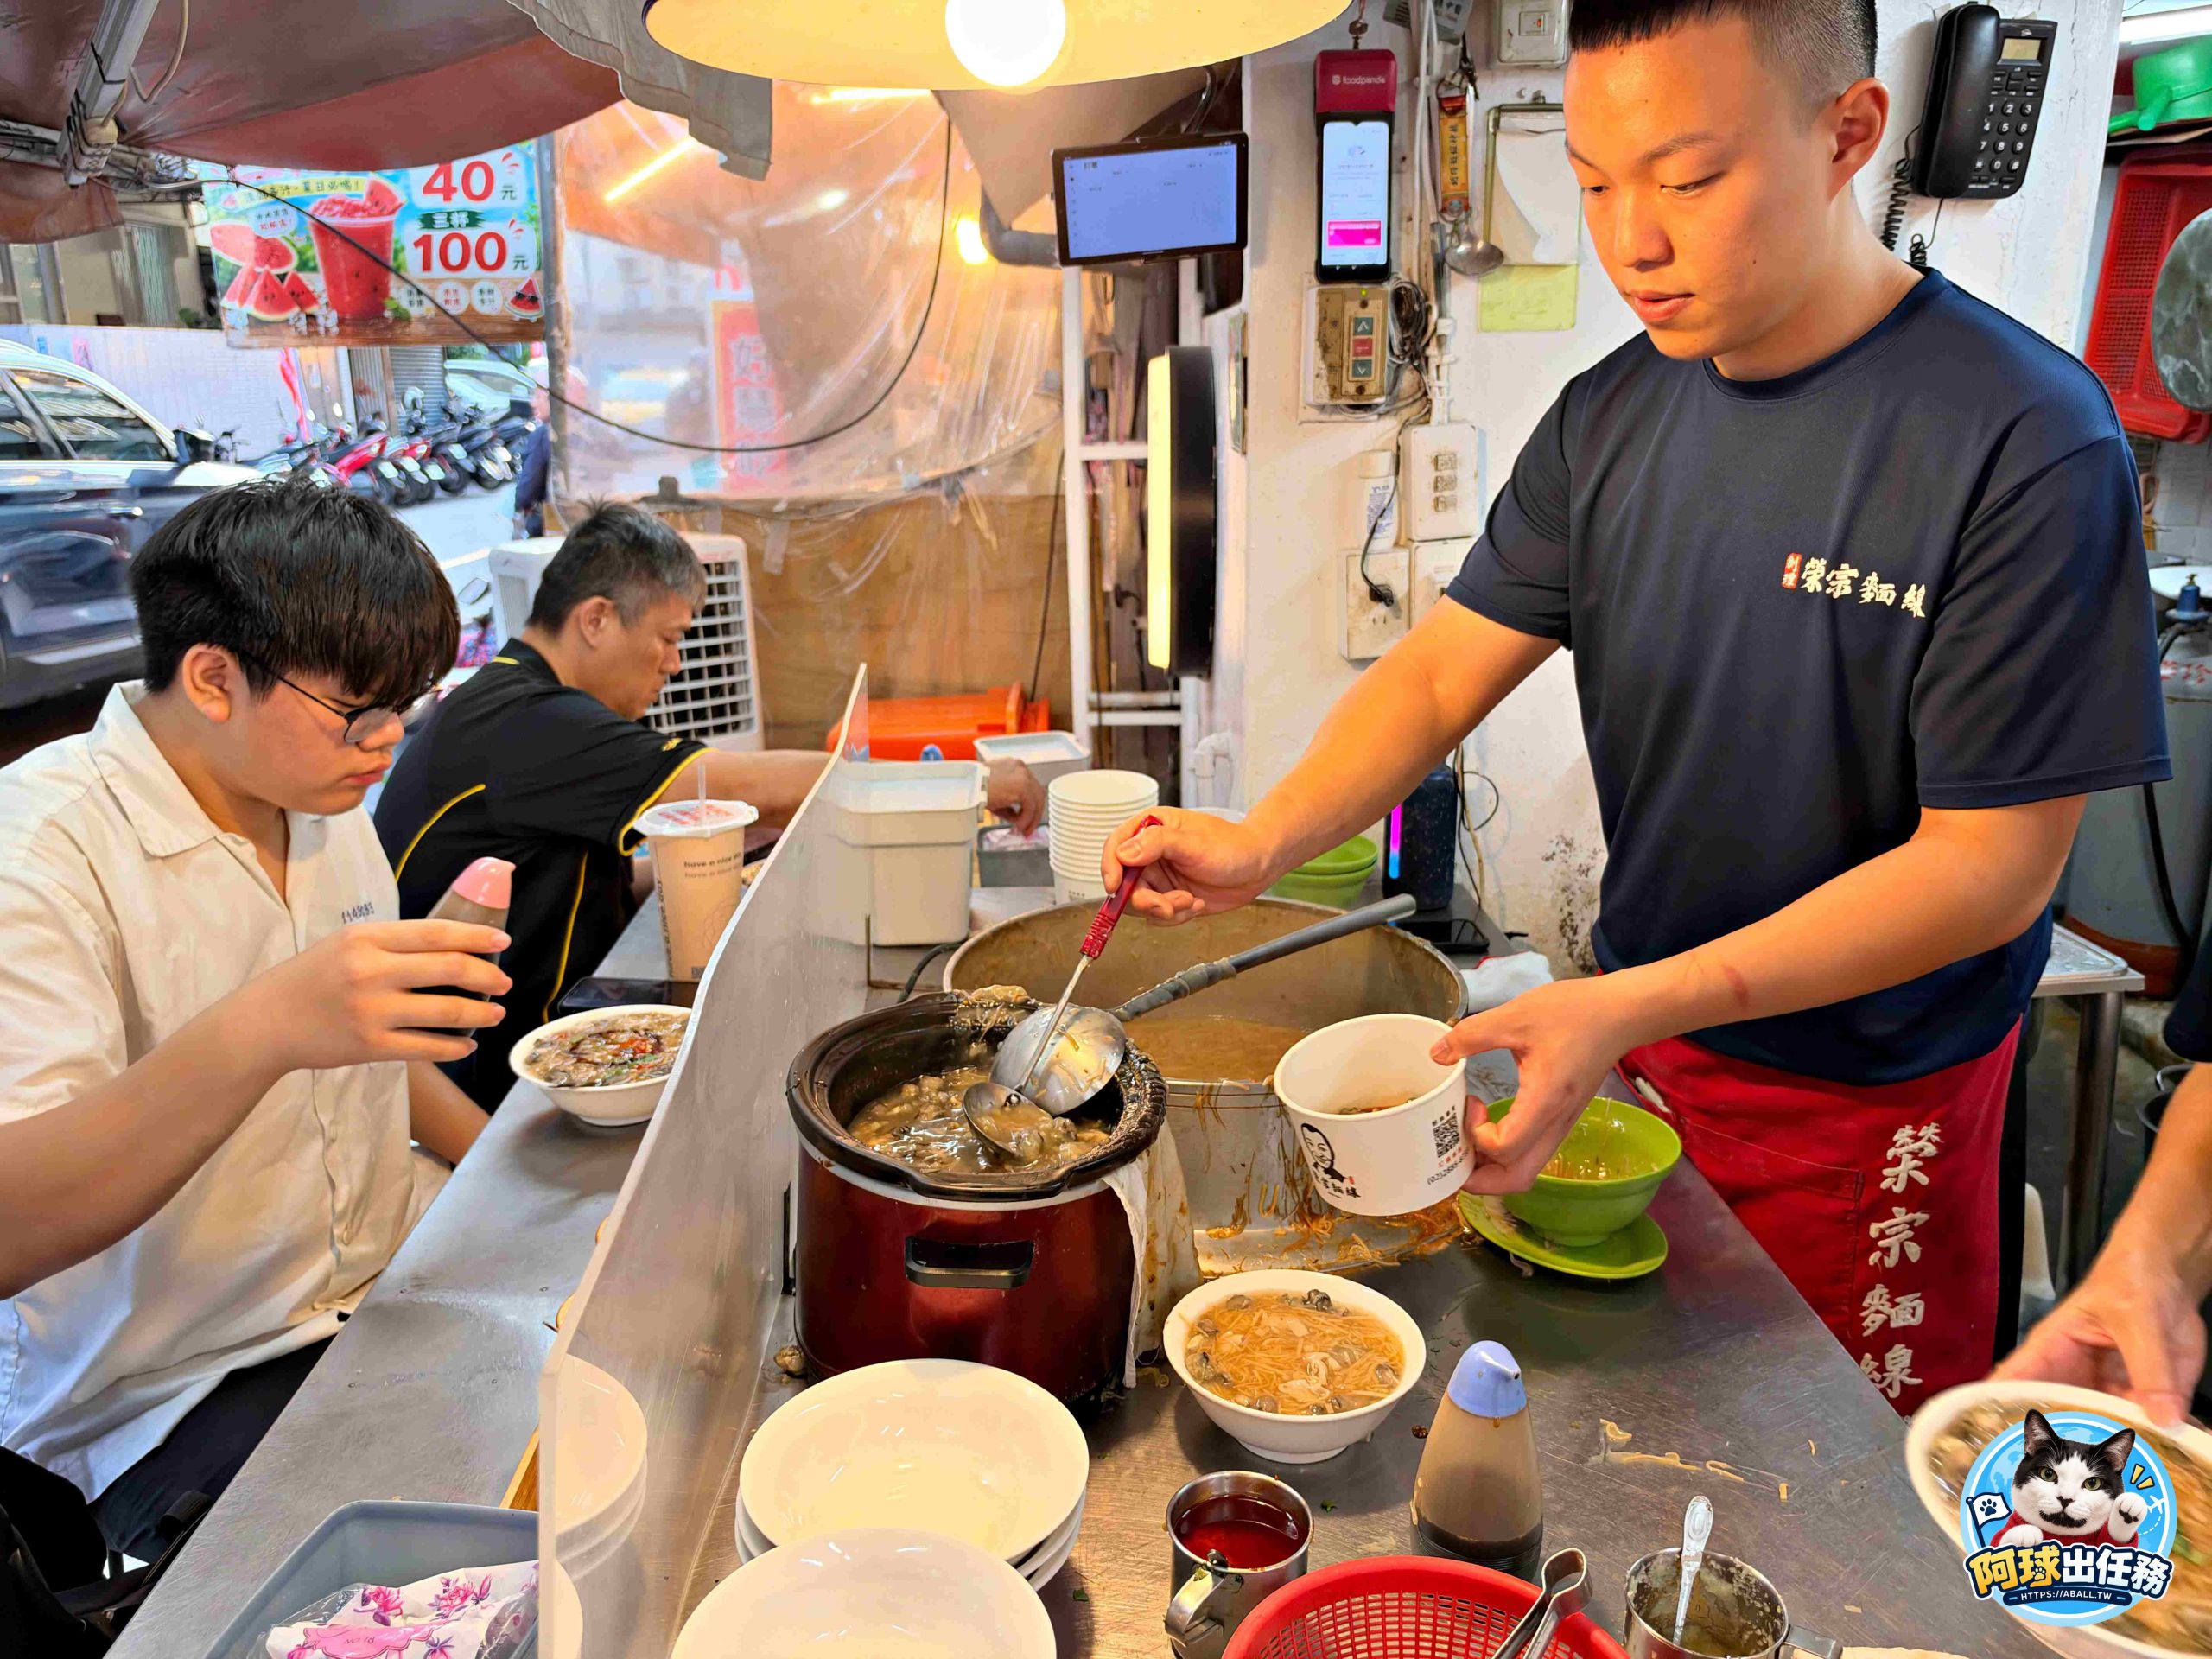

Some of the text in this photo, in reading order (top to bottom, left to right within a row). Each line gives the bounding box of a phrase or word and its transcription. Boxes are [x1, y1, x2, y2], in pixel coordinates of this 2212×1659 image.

[1988, 103, 2032, 114] 1 2 3
[2001, 123, 2010, 132] 5
[2020, 123, 2028, 133] 6
[1980, 141, 2024, 151] 7 8 9
[1993, 160, 2002, 170] 0
[422, 160, 518, 203] 40 元
[432, 211, 469, 229] 三杯
[412, 231, 530, 273] 100 元
[1800, 556, 1927, 619] 榮宗麵線
[1859, 1122, 1944, 1399] 榮宗麵線
